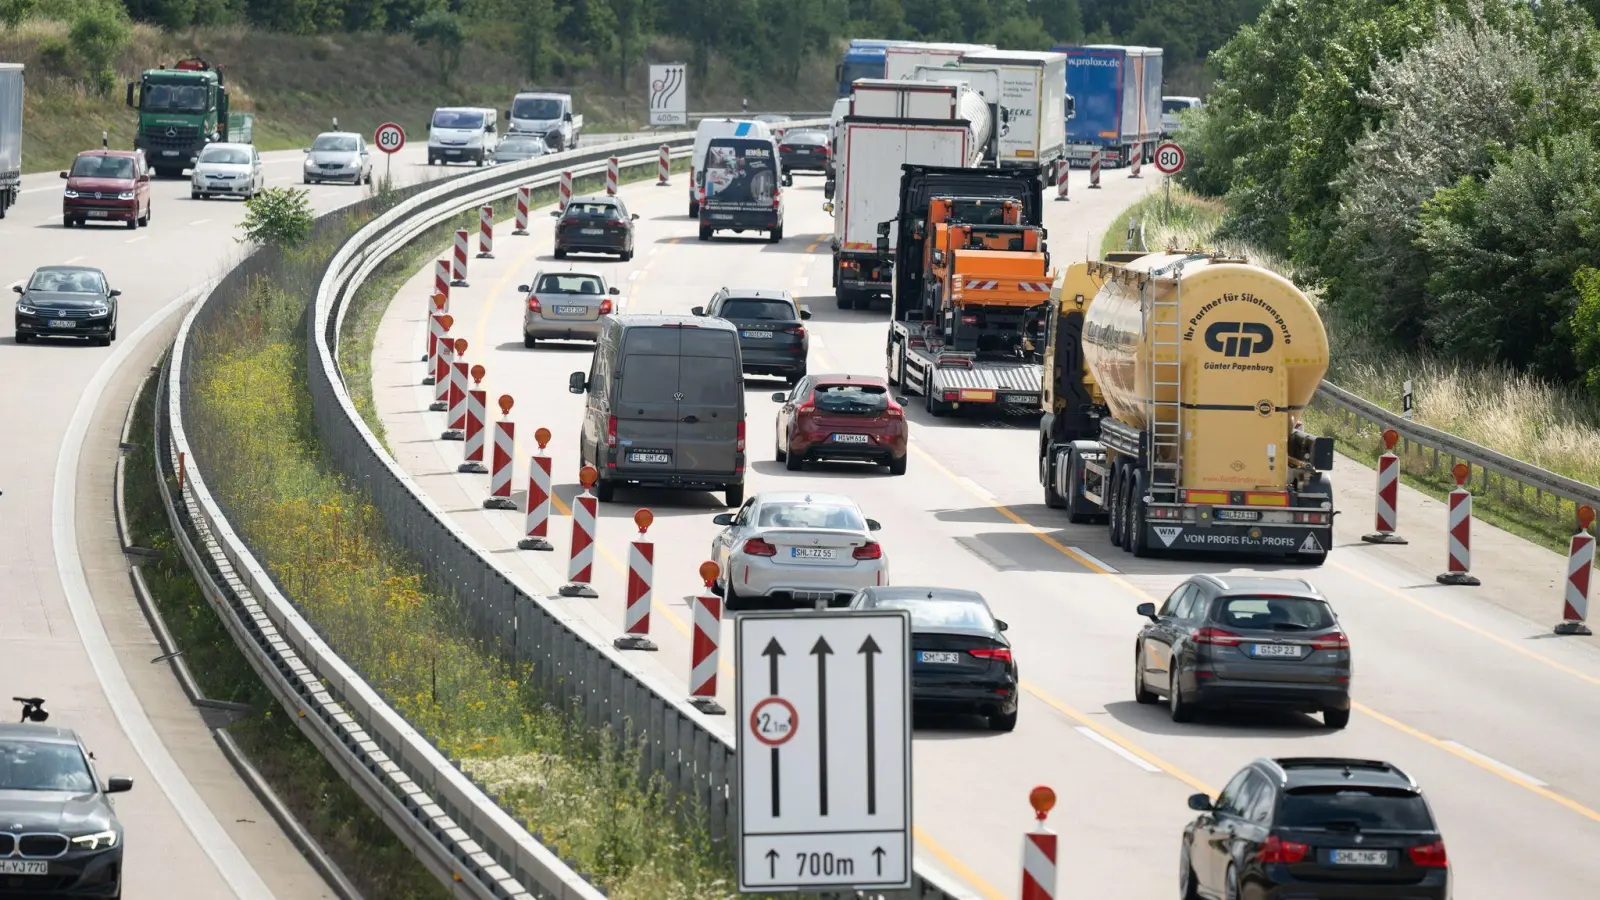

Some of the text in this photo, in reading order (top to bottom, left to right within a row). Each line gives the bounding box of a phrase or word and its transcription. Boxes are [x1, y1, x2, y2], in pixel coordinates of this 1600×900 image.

[1067, 57, 1120, 67] w.proloxx.de
[657, 114, 680, 122] 400m
[381, 131, 399, 145] 80
[1161, 152, 1178, 165] 80
[1183, 292, 1292, 344] Ihr Partner für Silotransporte
[1204, 362, 1274, 374] Günter Papenburg
[1159, 528, 1176, 536] WM
[1183, 534, 1206, 543] VON
[1207, 535, 1240, 545] PROFIS
[1262, 537, 1295, 546] PROFIS
[796, 548, 809, 556] SHL
[814, 549, 822, 557] ZZ
[1261, 645, 1295, 654] G SP 23
[923, 653, 958, 662] SM JF 3
[1337, 850, 1387, 863] SHL NF 9
[12, 861, 26, 872] YJ
[26, 861, 46, 872] 770
[796, 852, 854, 876] 700m
